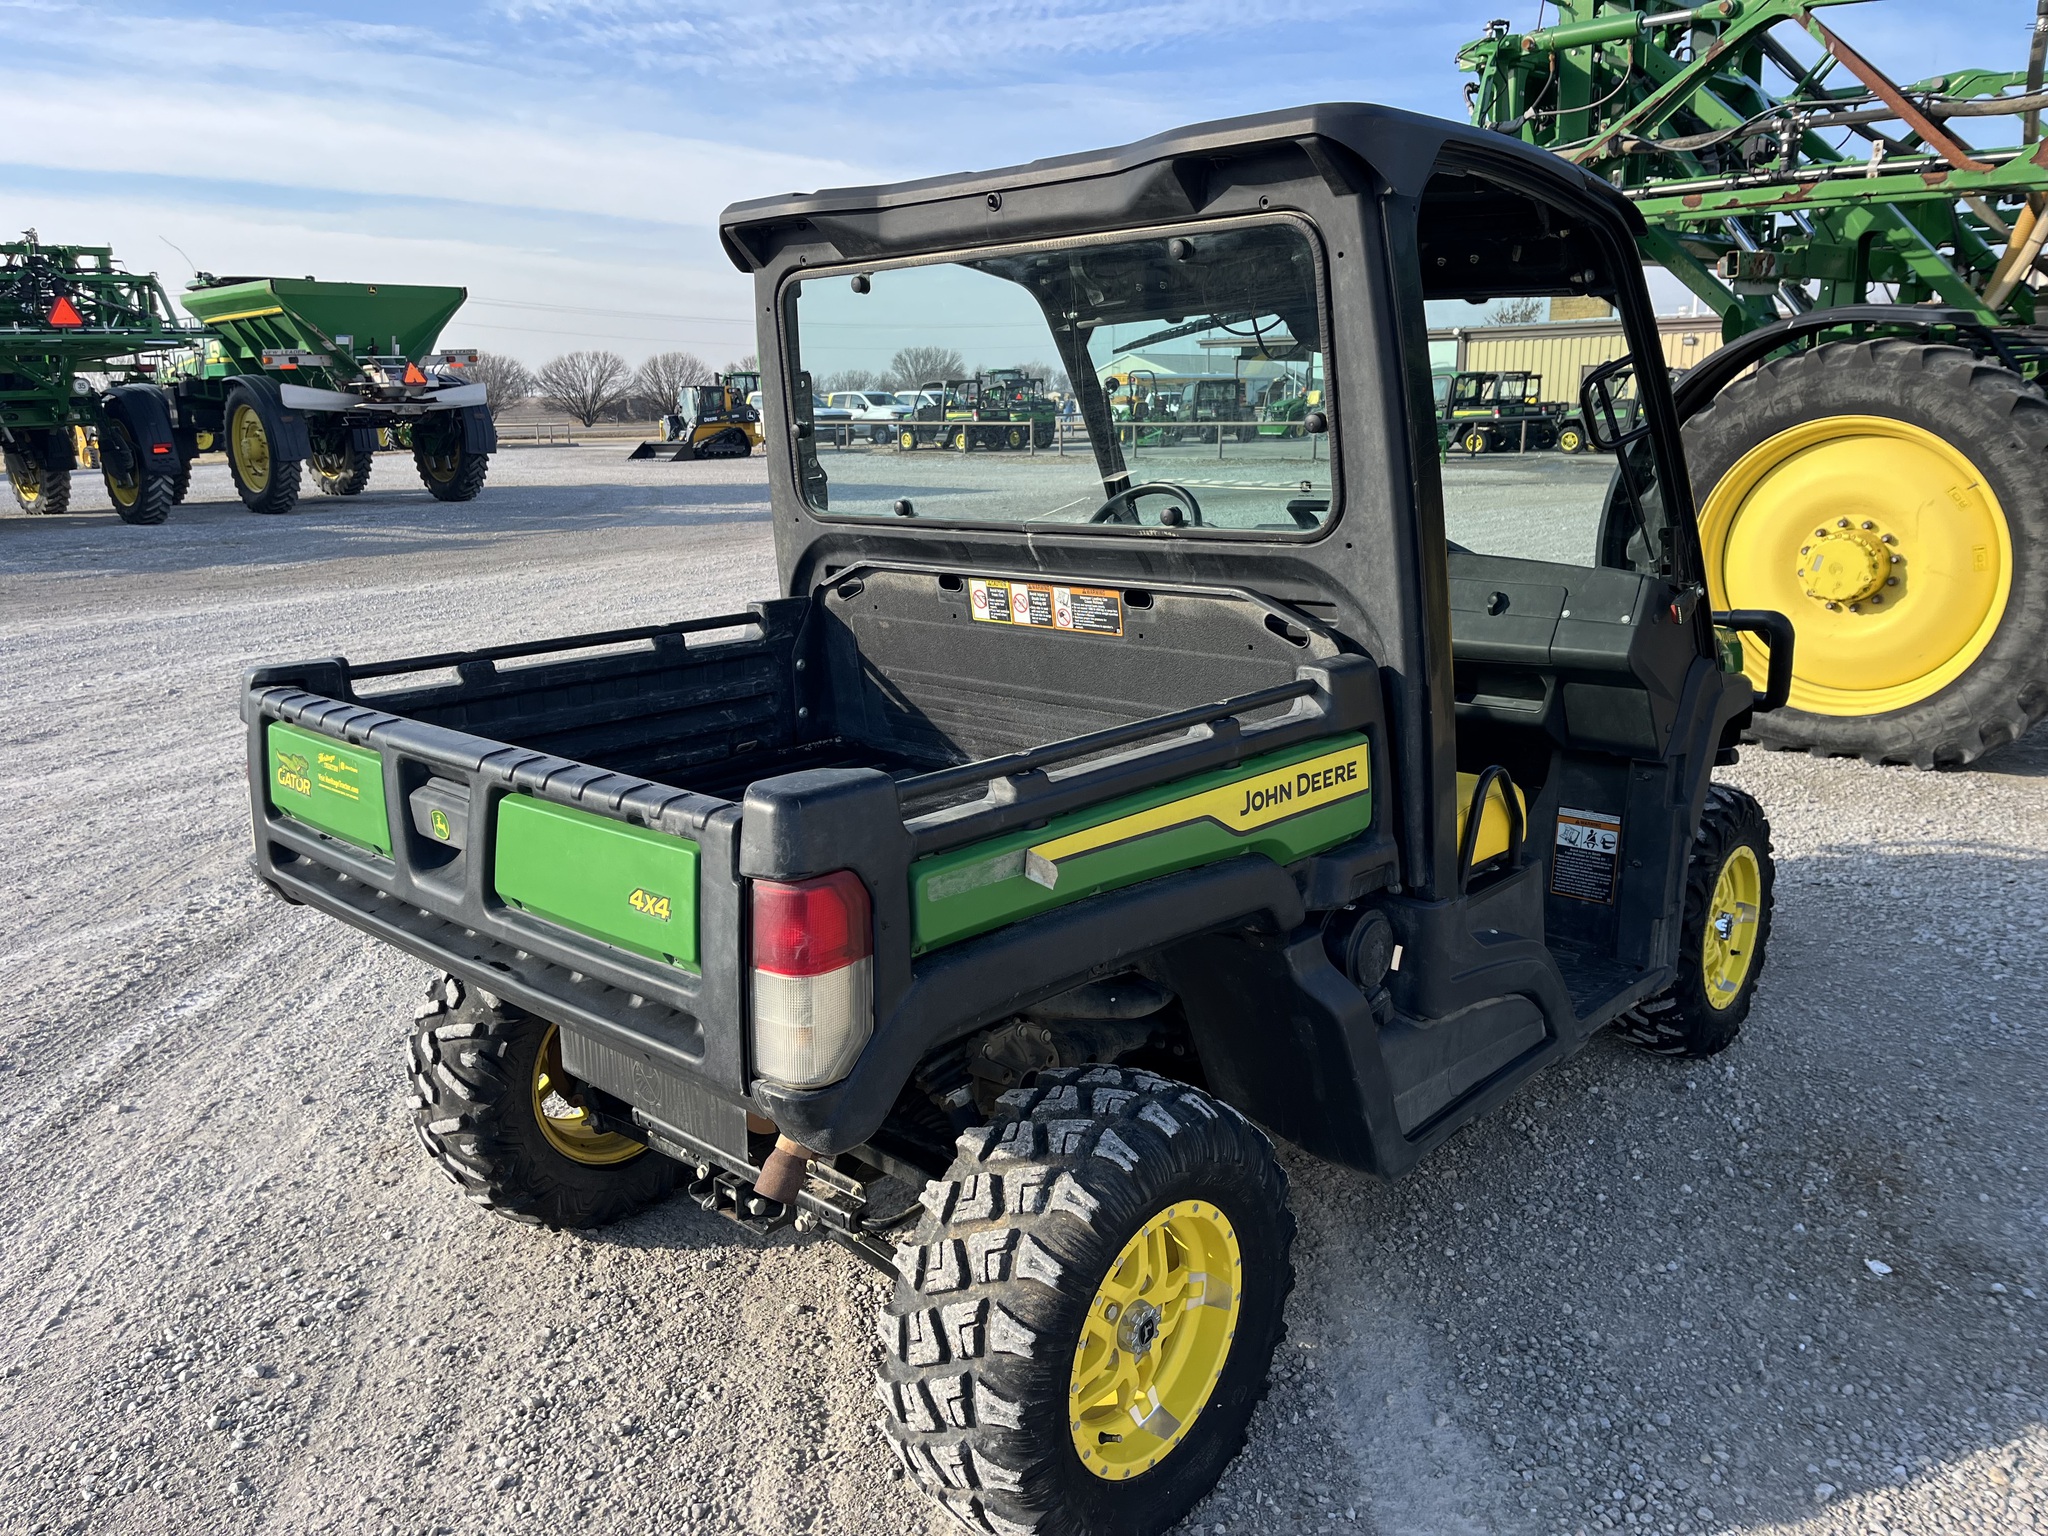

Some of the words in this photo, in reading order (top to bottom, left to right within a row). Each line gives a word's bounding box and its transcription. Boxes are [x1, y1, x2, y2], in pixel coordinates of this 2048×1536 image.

[277, 767, 312, 797] GATOR
[1240, 781, 1292, 816] JOHN
[1297, 761, 1358, 797] DEERE
